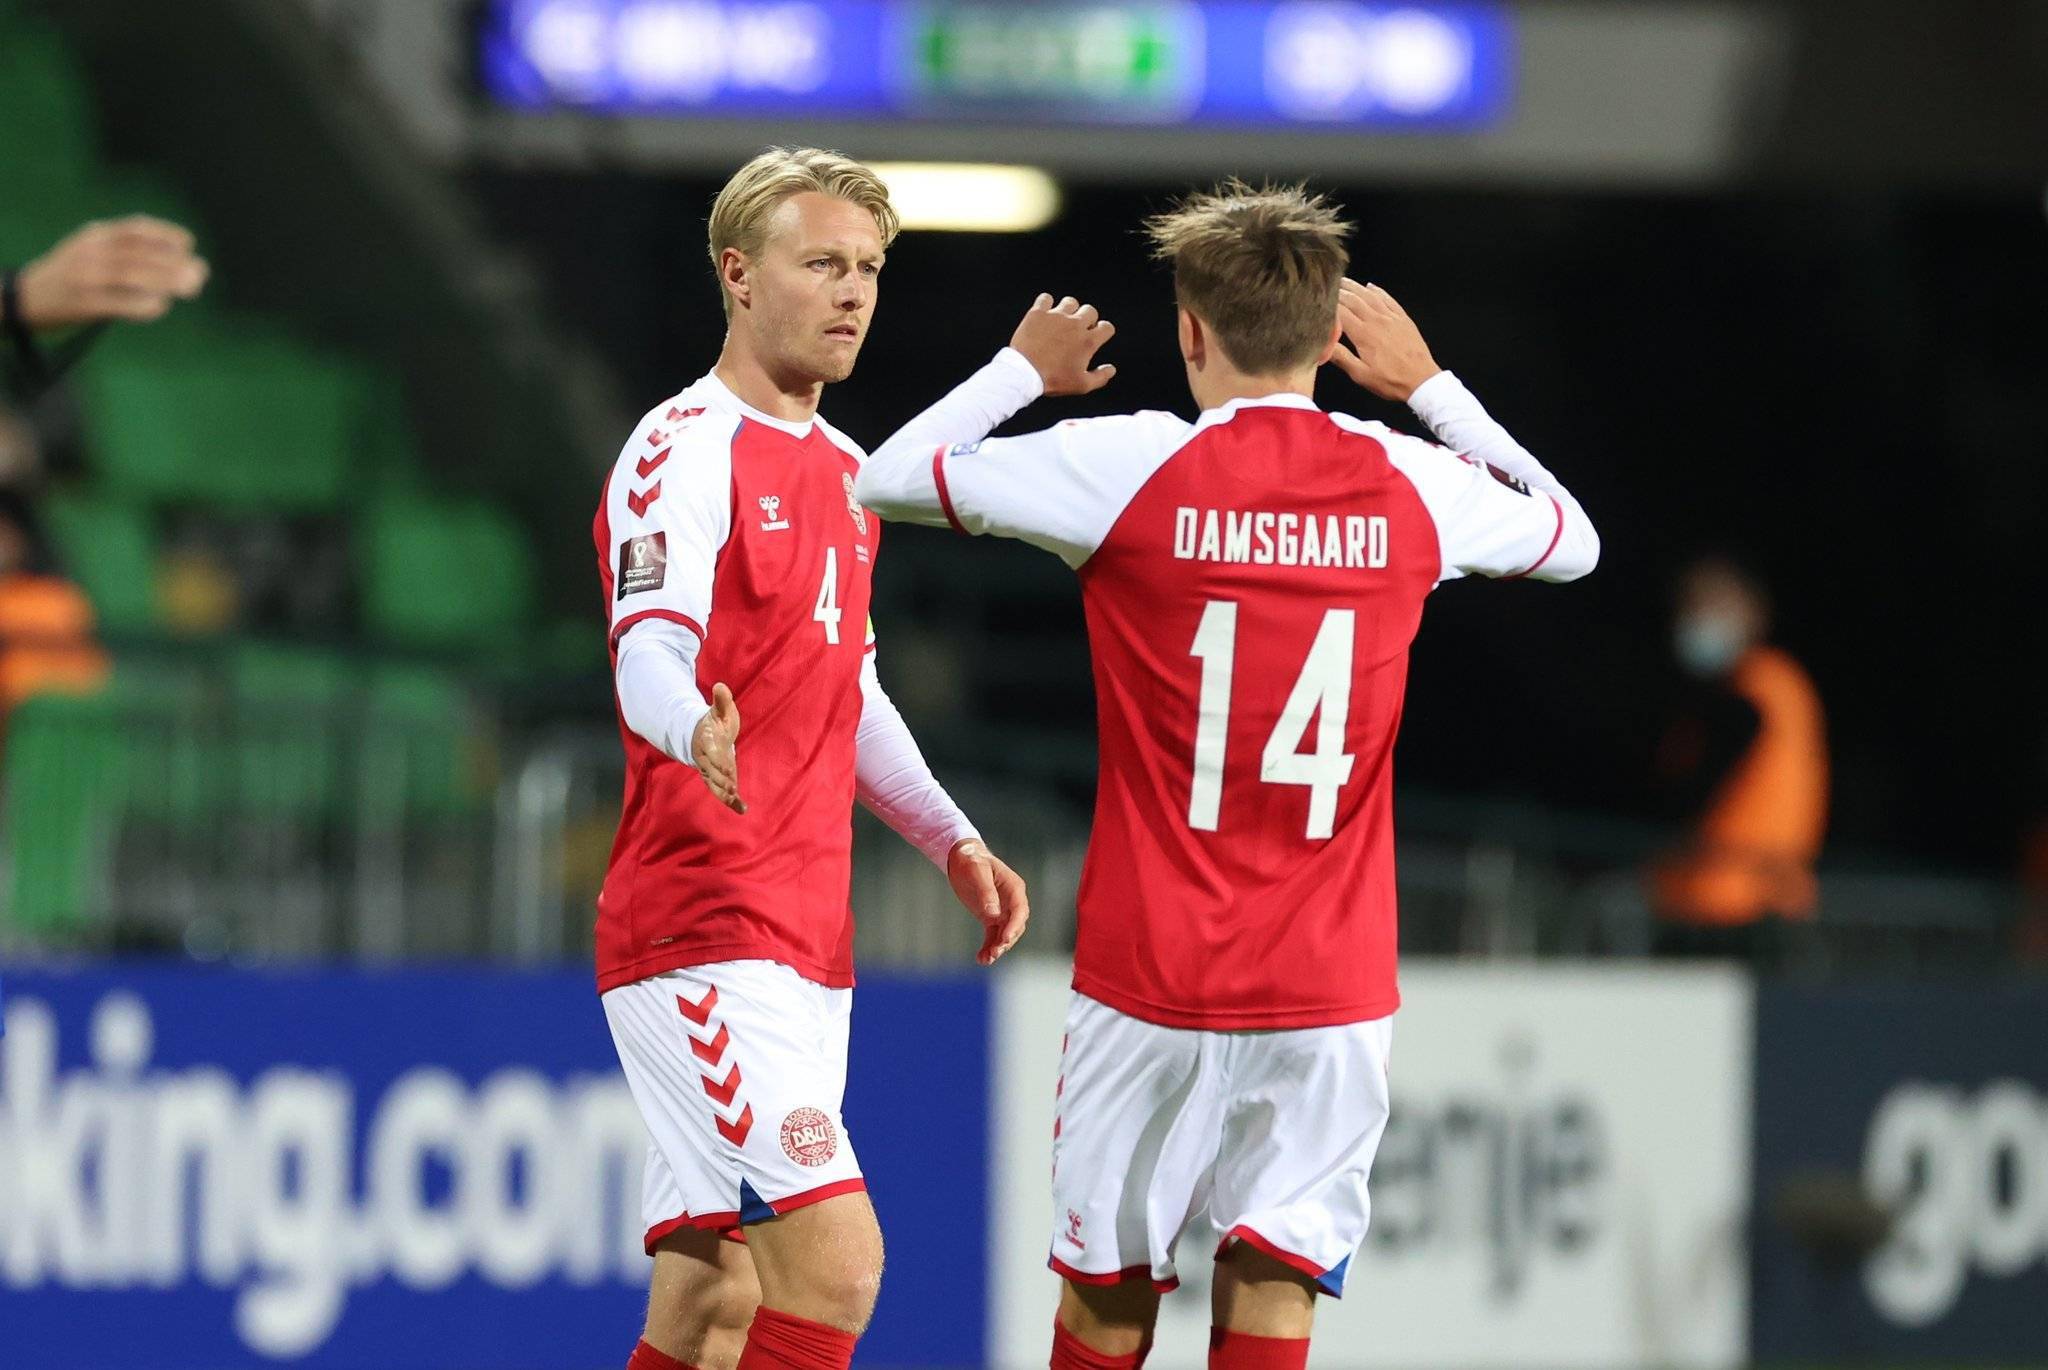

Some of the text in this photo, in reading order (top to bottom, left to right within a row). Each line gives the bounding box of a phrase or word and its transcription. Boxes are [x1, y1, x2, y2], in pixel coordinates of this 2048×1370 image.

[1174, 506, 1388, 569] DAMSGAARD
[813, 547, 841, 645] 4
[1188, 600, 1355, 840] 14
[791, 1125, 828, 1148] DBU
